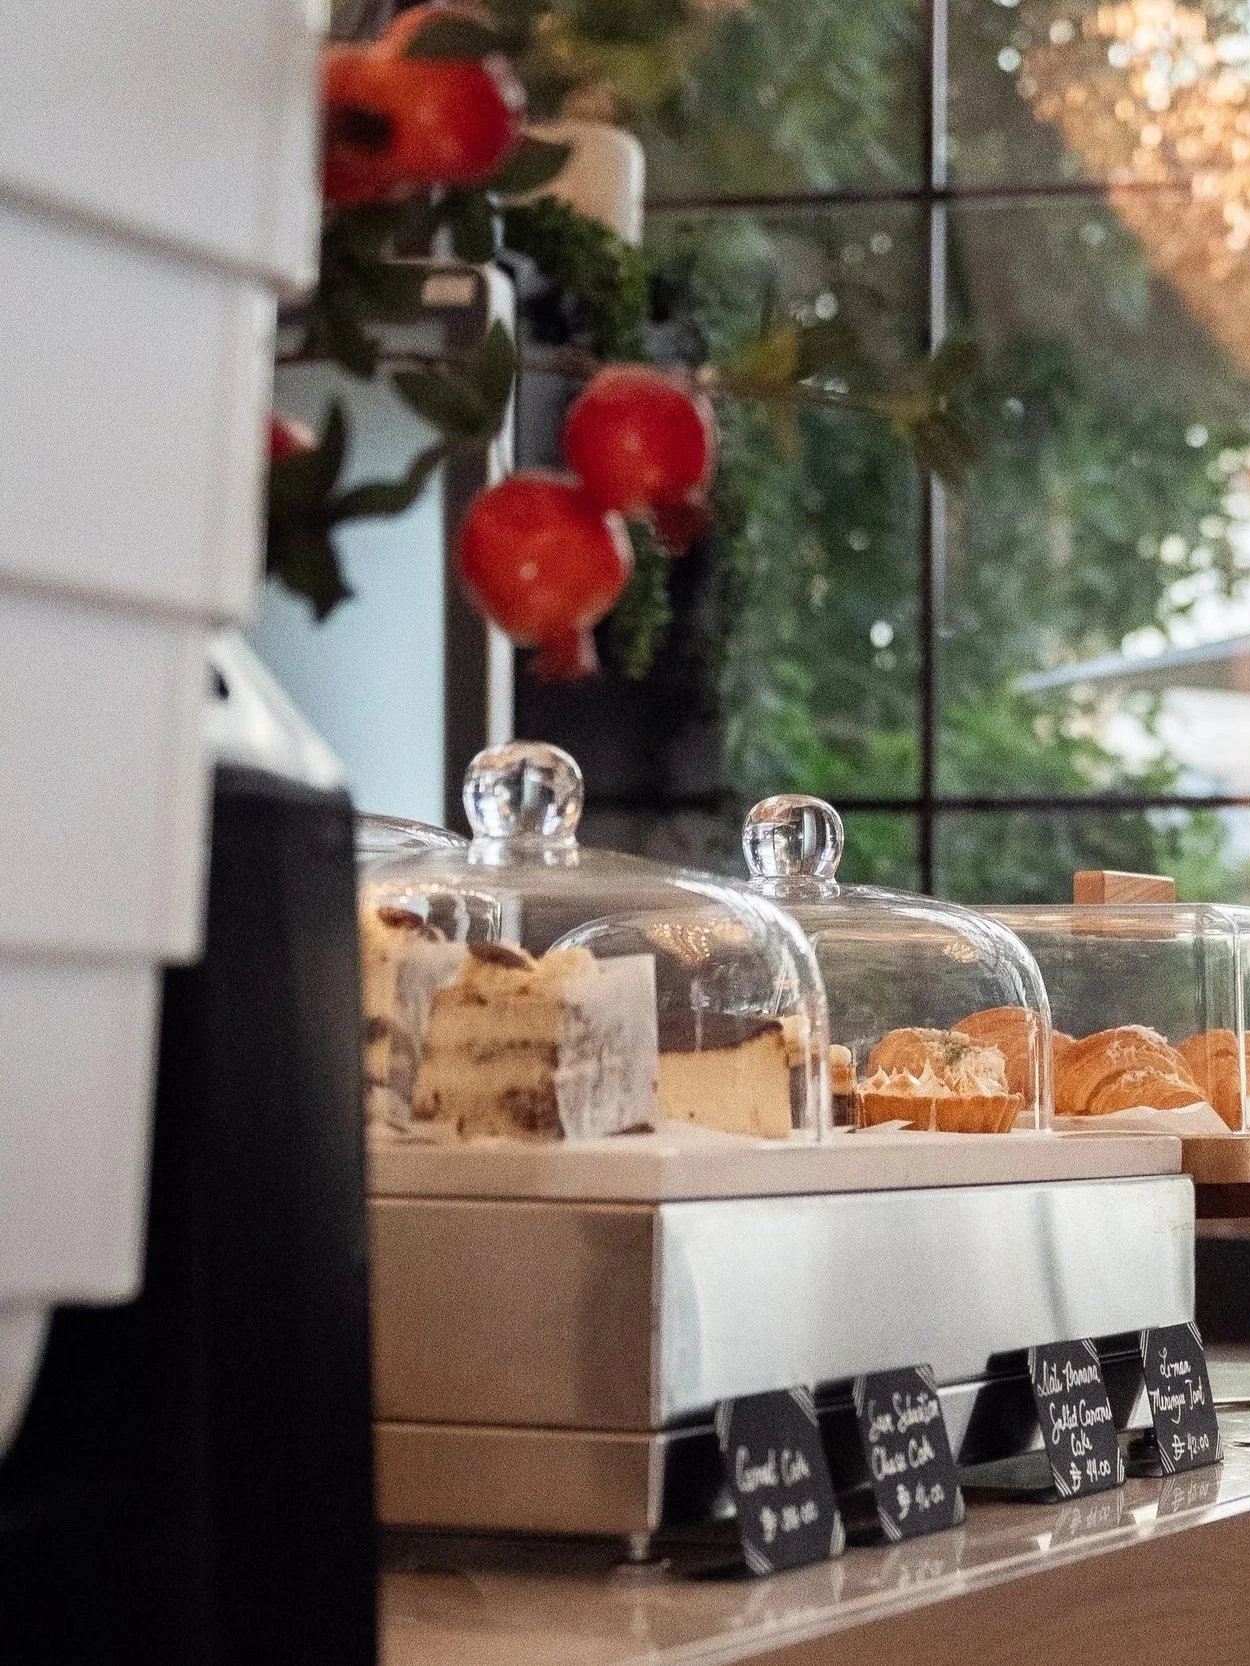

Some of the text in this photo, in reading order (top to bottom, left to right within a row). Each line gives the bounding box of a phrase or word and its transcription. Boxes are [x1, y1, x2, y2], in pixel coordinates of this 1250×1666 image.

[1049, 1402, 1078, 1445] Salted
[1071, 1428, 1093, 1457] Cake
[1187, 1432, 1209, 1460] 42.00
